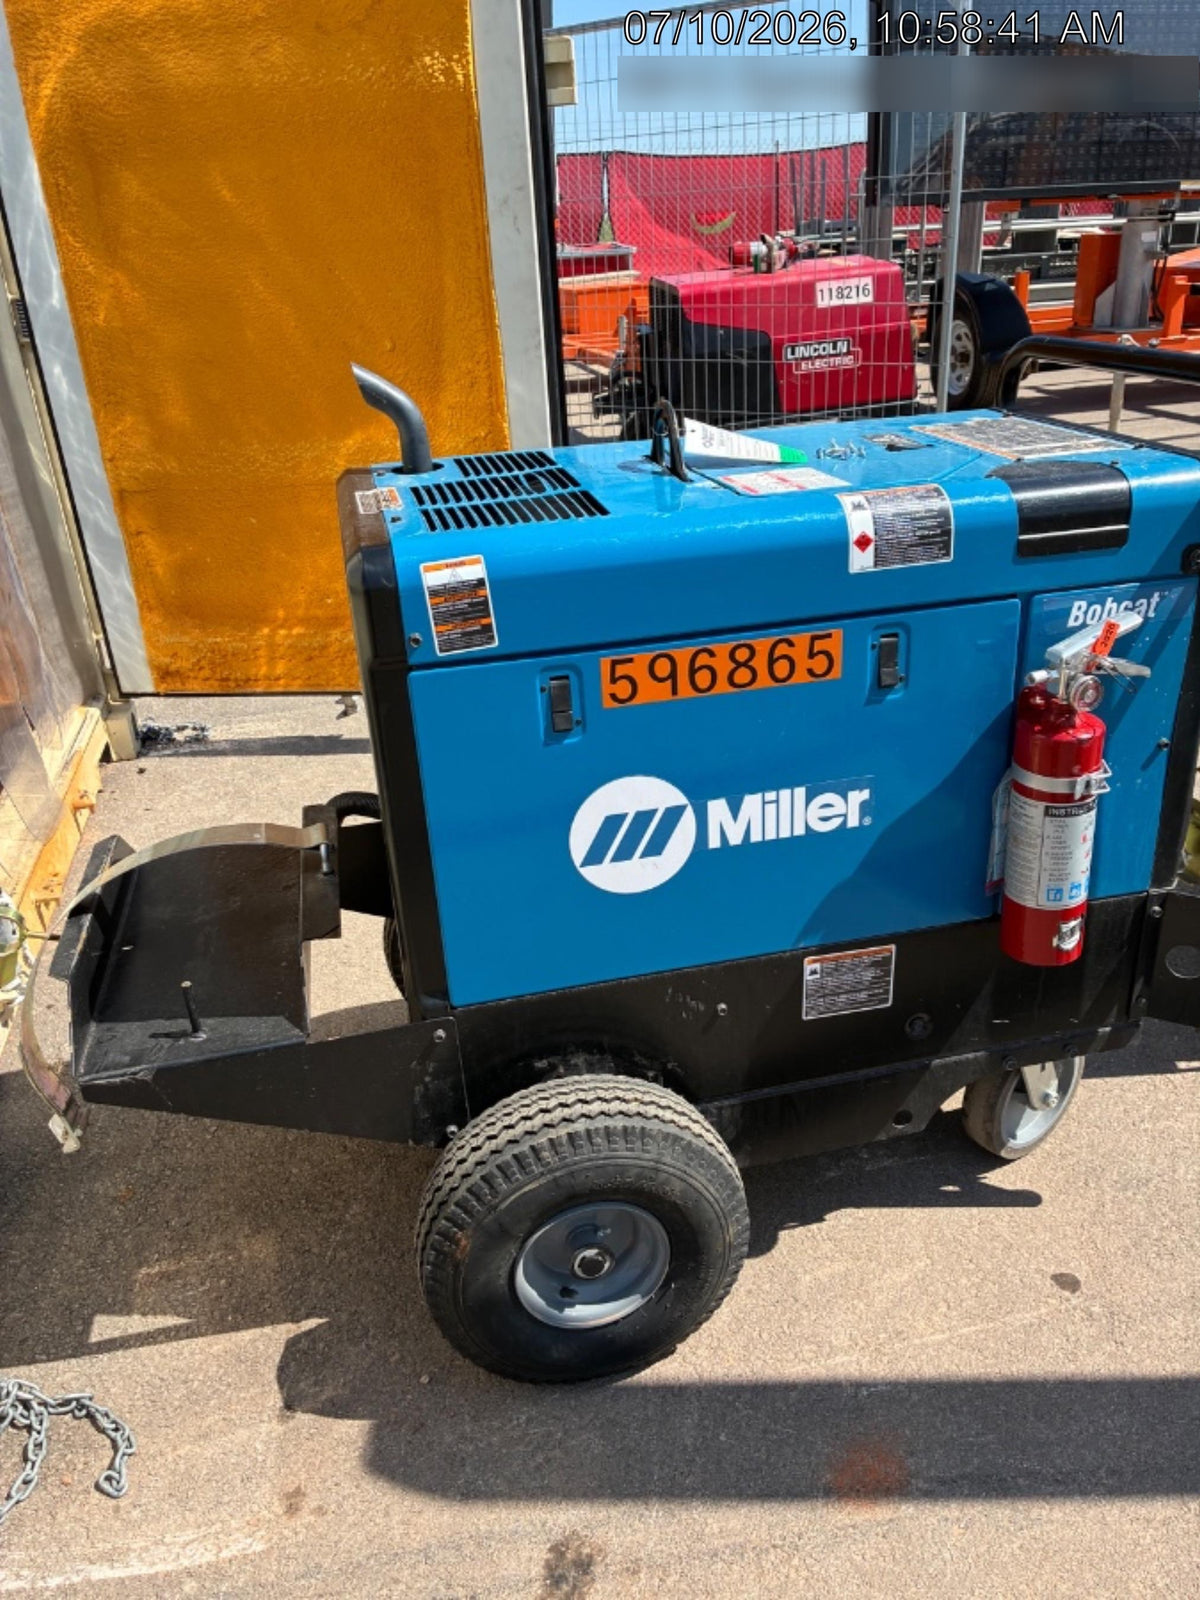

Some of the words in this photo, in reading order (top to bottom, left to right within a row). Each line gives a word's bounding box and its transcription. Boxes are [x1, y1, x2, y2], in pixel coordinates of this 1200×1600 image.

[819, 283, 871, 302] 118216
[786, 340, 849, 360] LINCOLN
[801, 355, 854, 371] ELECTRIC
[608, 632, 836, 705] 596865
